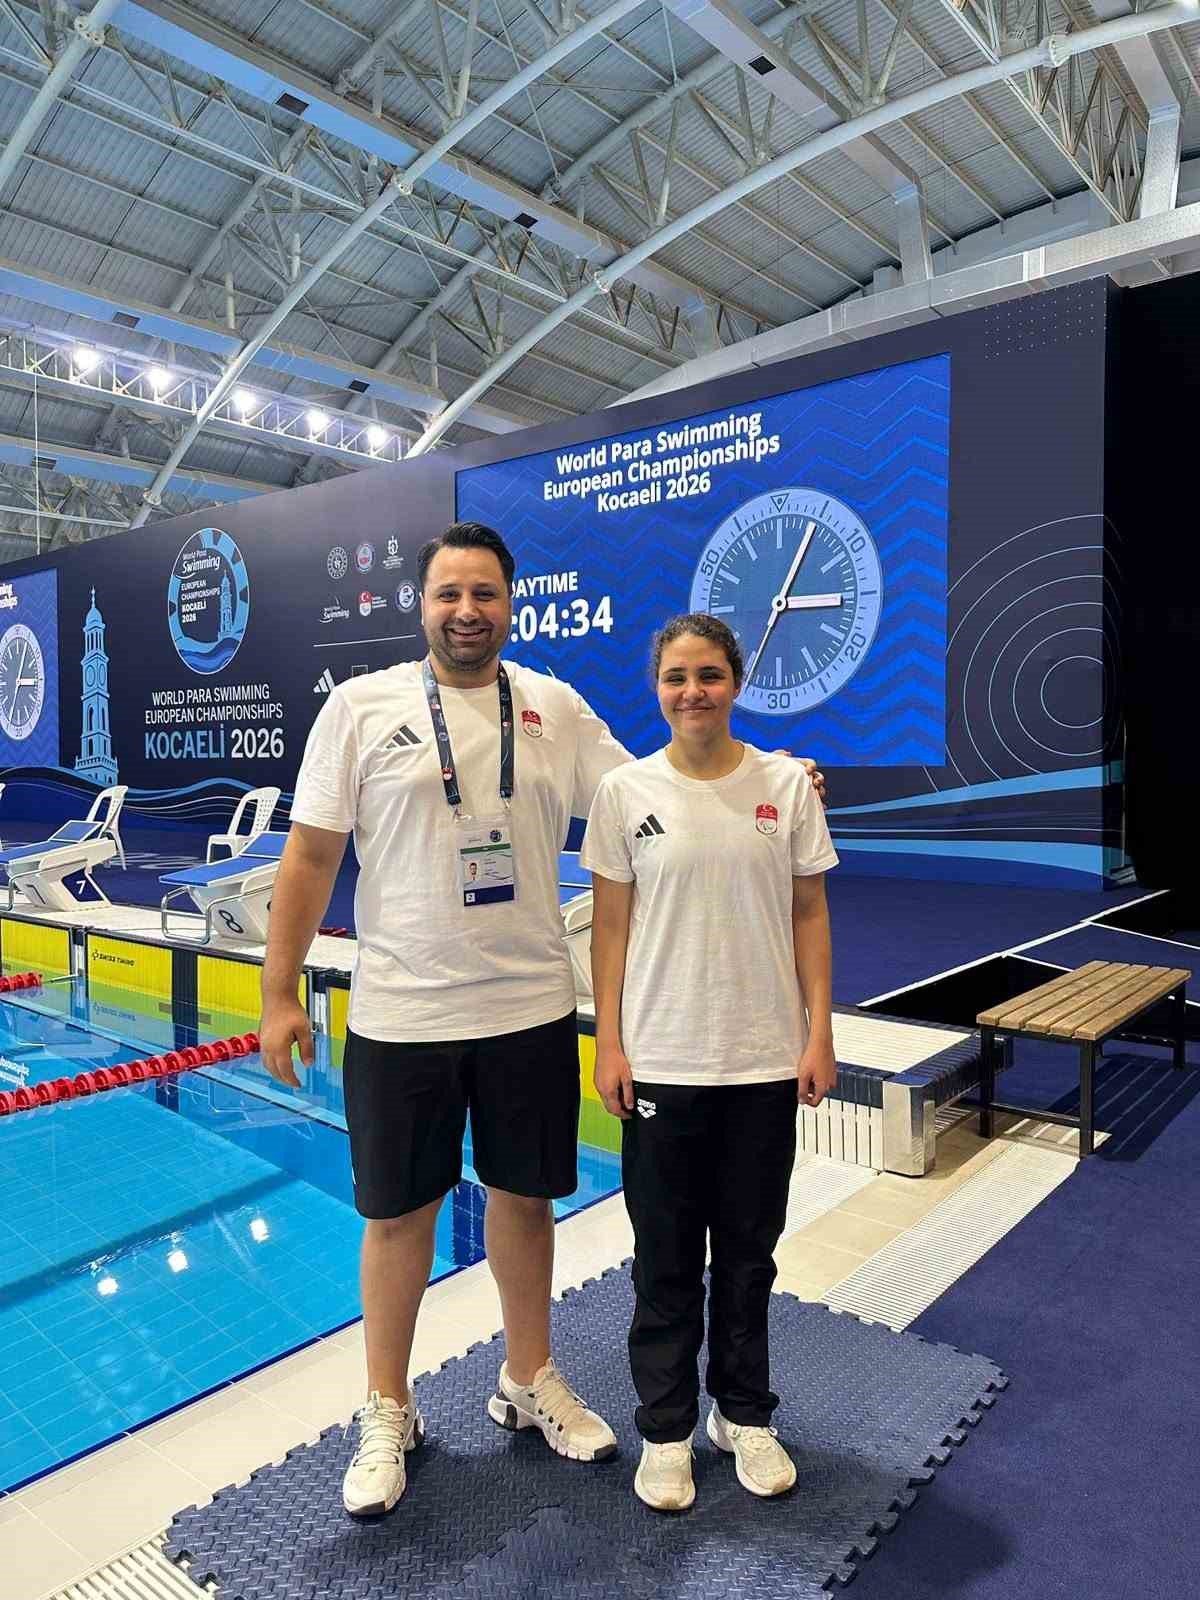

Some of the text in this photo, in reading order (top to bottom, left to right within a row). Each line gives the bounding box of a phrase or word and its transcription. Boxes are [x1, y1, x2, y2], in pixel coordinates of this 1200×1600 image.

[557, 412, 762, 475] World Para Swimming
[543, 433, 780, 501] European Championships
[597, 471, 711, 513] Kocaeli 2026
[846, 528, 866, 552] 10
[182, 556, 220, 573] Swimming
[701, 550, 720, 576] 50
[181, 579, 207, 591] EUROPEAN
[181, 587, 220, 600] CHAMPIONSHIPS
[182, 613, 197, 623] 2026
[845, 633, 866, 662] 20
[152, 683, 270, 706] WORLD PARA SWIMMING
[767, 693, 791, 709] 30
[145, 702, 284, 725] EUROPEAN CHAMPIONSHIPS
[144, 723, 285, 760] KOCAELİ 2026
[76, 880, 86, 894] 7
[218, 909, 244, 934] 8
